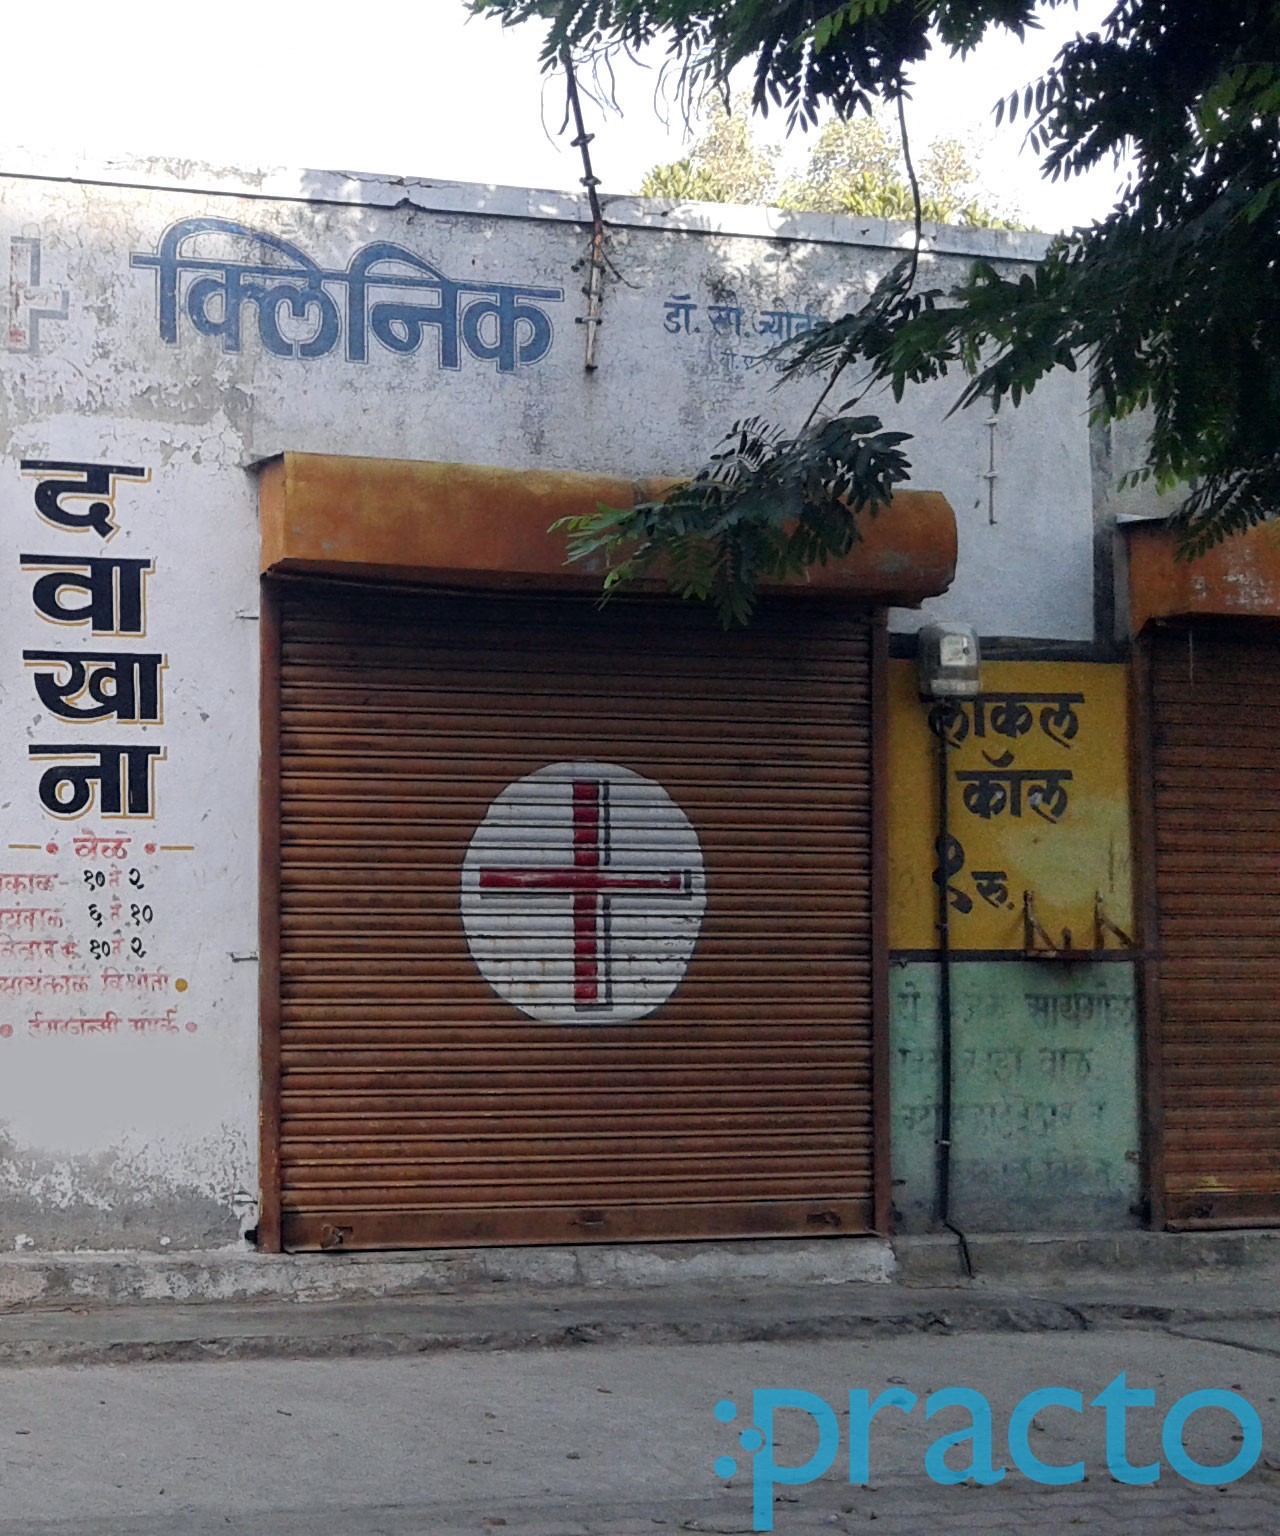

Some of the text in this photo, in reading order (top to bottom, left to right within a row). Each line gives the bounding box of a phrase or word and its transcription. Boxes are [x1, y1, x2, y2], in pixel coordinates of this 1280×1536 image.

[129, 216, 565, 373] क्लिनिक
[663, 293, 701, 335] डॉ.
[83, 869, 106, 892] १०
[129, 867, 145, 890] २
[130, 903, 154, 926] १०
[89, 938, 111, 961] १०
[131, 936, 147, 958] २
